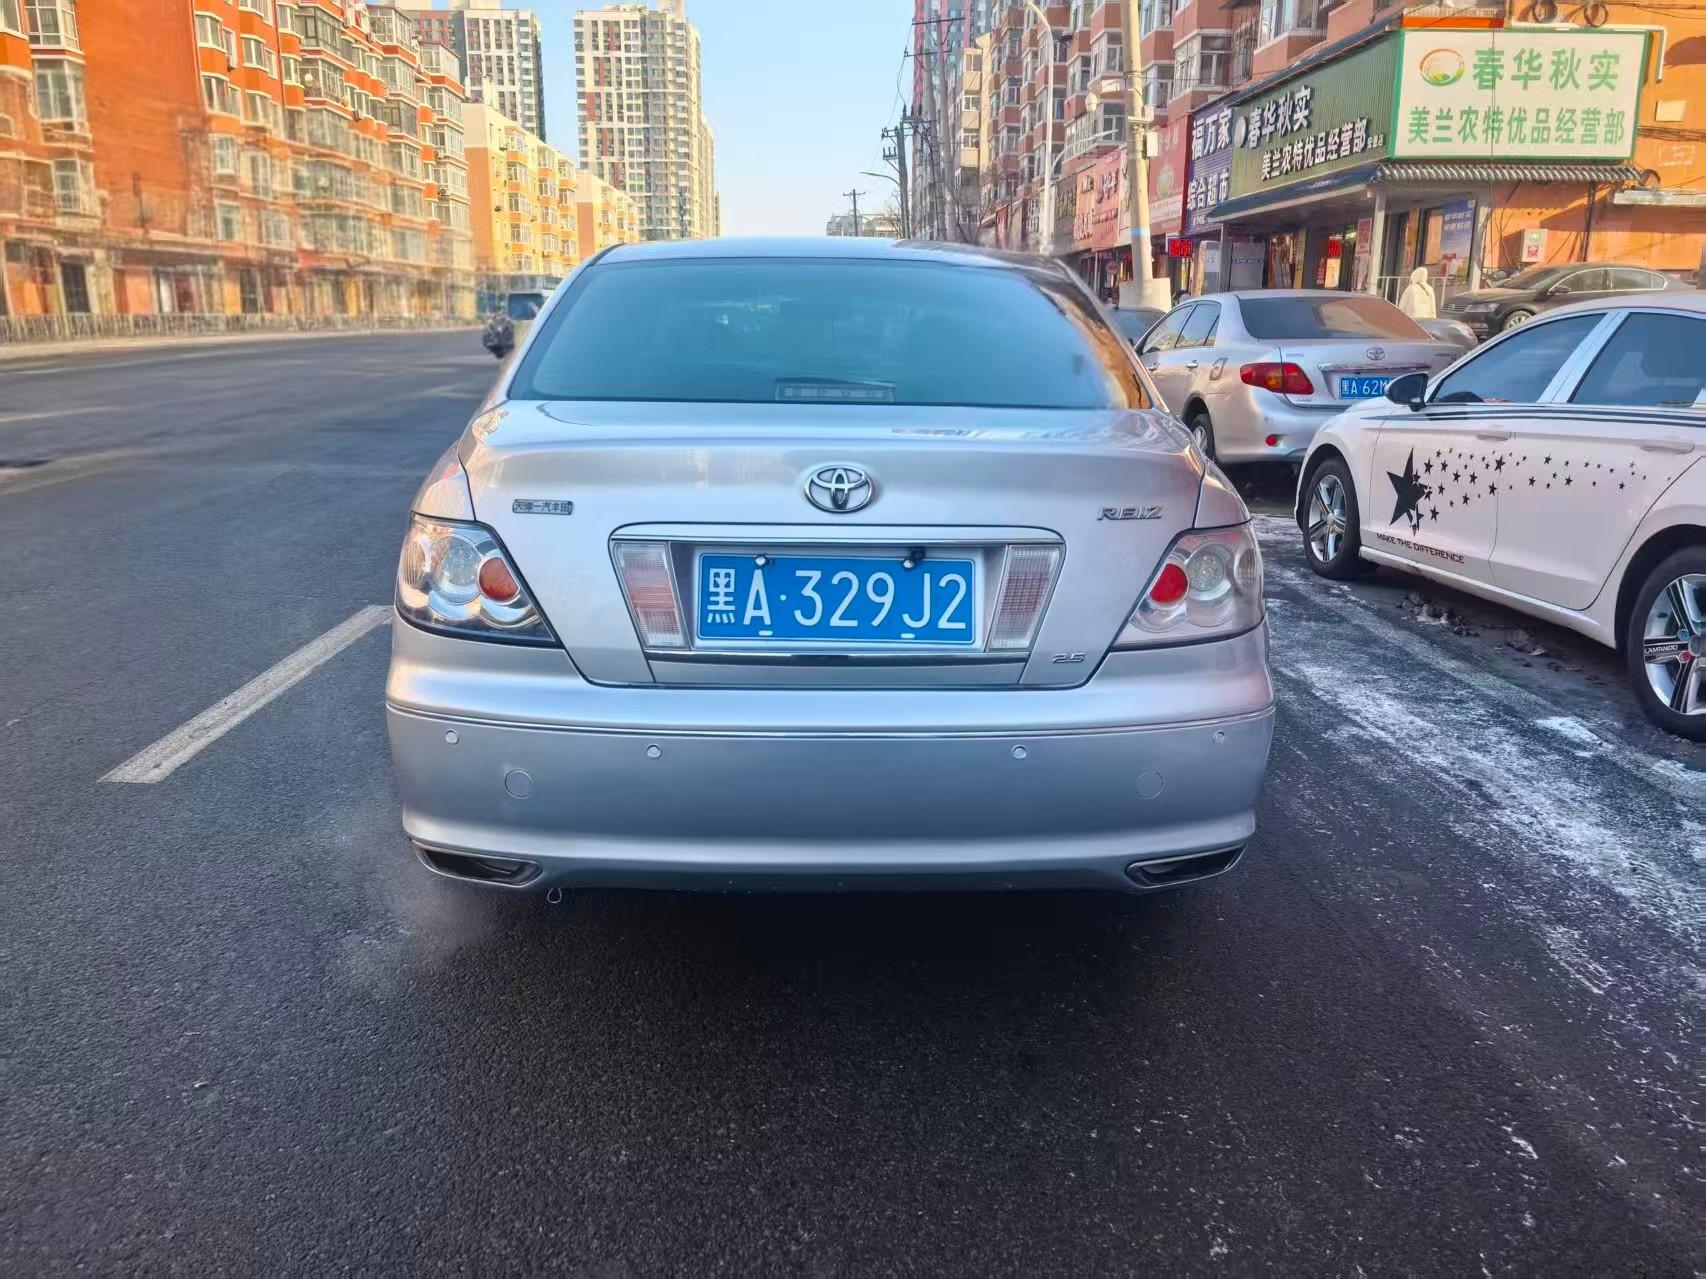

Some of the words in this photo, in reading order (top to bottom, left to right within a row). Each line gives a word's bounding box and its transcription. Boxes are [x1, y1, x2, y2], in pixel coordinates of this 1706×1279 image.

[1472, 47, 1620, 91] 春华秋实
[1192, 108, 1232, 160] 福万家
[1248, 85, 1311, 148] 春华秋实
[1407, 105, 1626, 145] 美兰农特优品经营部
[1261, 116, 1368, 181] 美兰农特优品经营部
[1187, 168, 1229, 210] 综合超市
[1341, 379, 1391, 395] 黑A·62M
[1097, 505, 1163, 521] REIZ
[1376, 532, 1396, 545] MAKE
[1397, 537, 1412, 549] THE
[1413, 543, 1465, 564] DIFFERENCE
[706, 567, 967, 630] 黑A·329J2
[1644, 645, 1678, 653] LAMANDO
